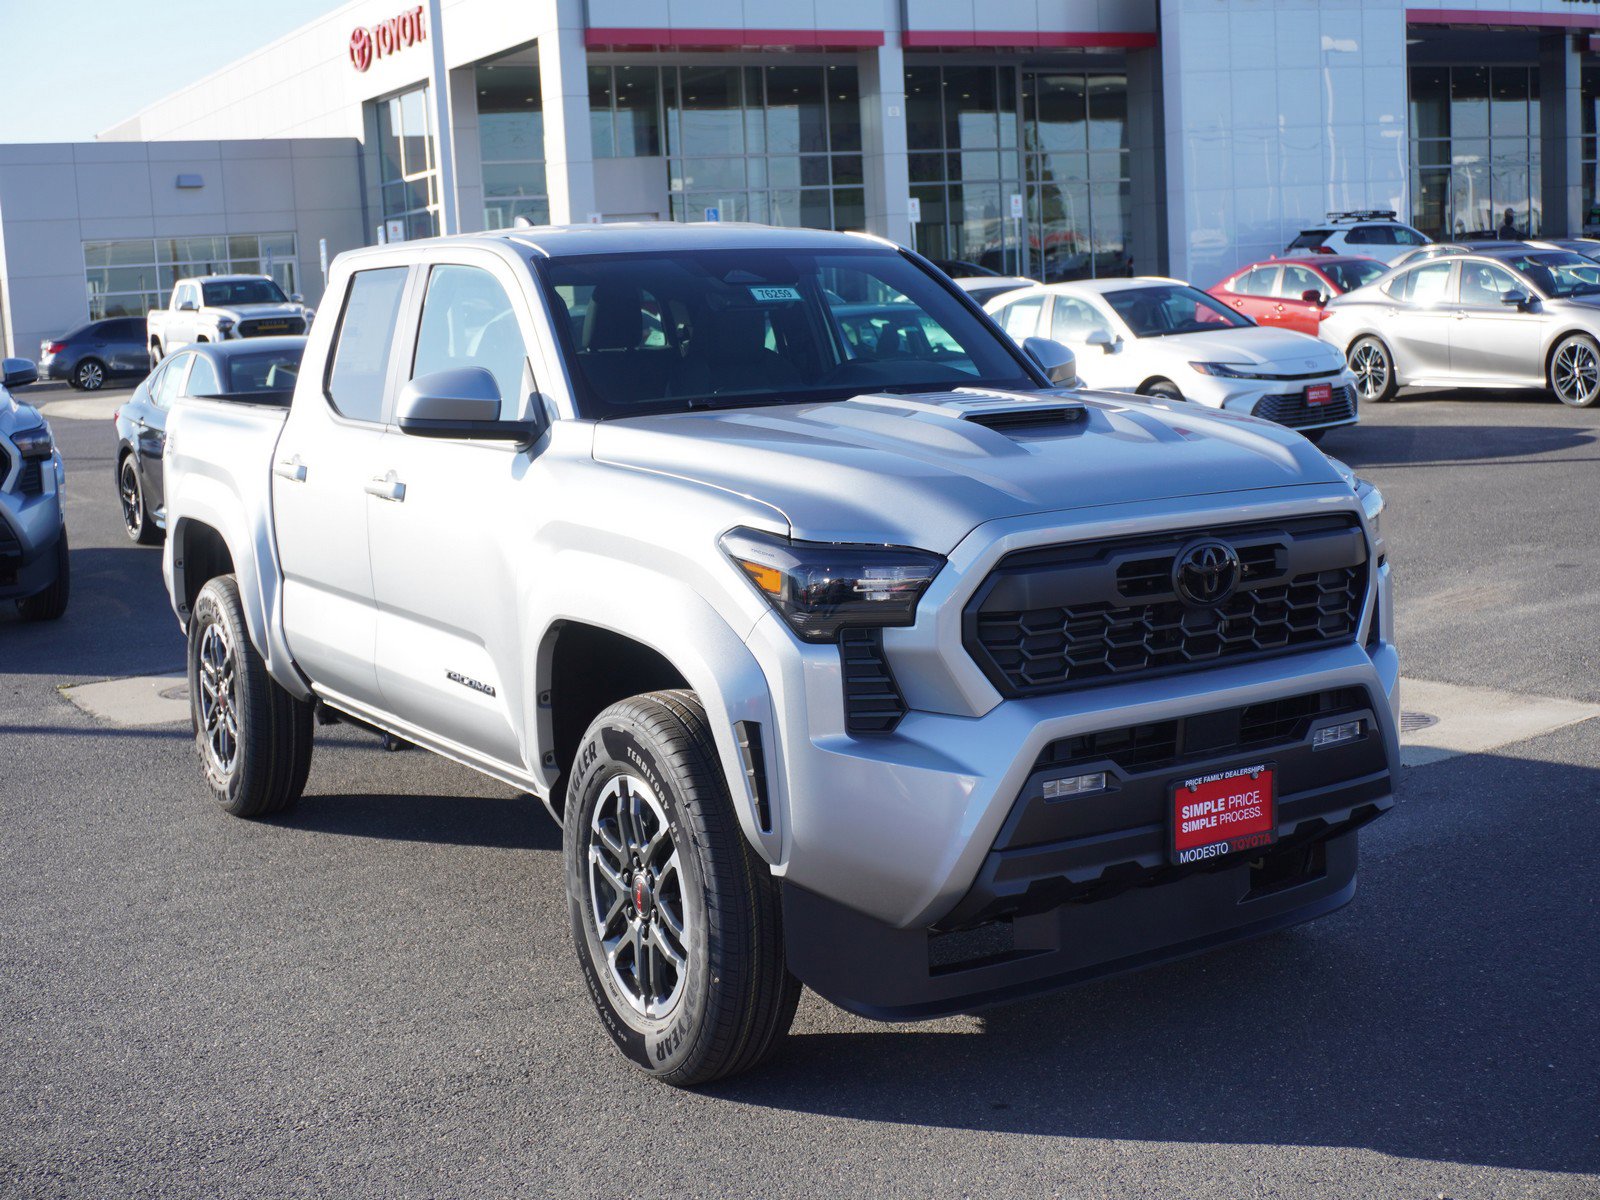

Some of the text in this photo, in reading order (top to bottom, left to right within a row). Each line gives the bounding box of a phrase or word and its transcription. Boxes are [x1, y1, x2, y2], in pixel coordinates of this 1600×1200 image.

[372, 4, 427, 60] TOYOT
[757, 289, 793, 299] 76259
[626, 746, 670, 811] TERRITORY
[1185, 764, 1265, 788] PRICE FAMILY DEALERSHIPS
[1182, 790, 1263, 819] SIMPLE PRICE.
[1182, 806, 1263, 833] SIMPLE PROCESS.
[1180, 833, 1272, 864] MODESTO TOYOTA
